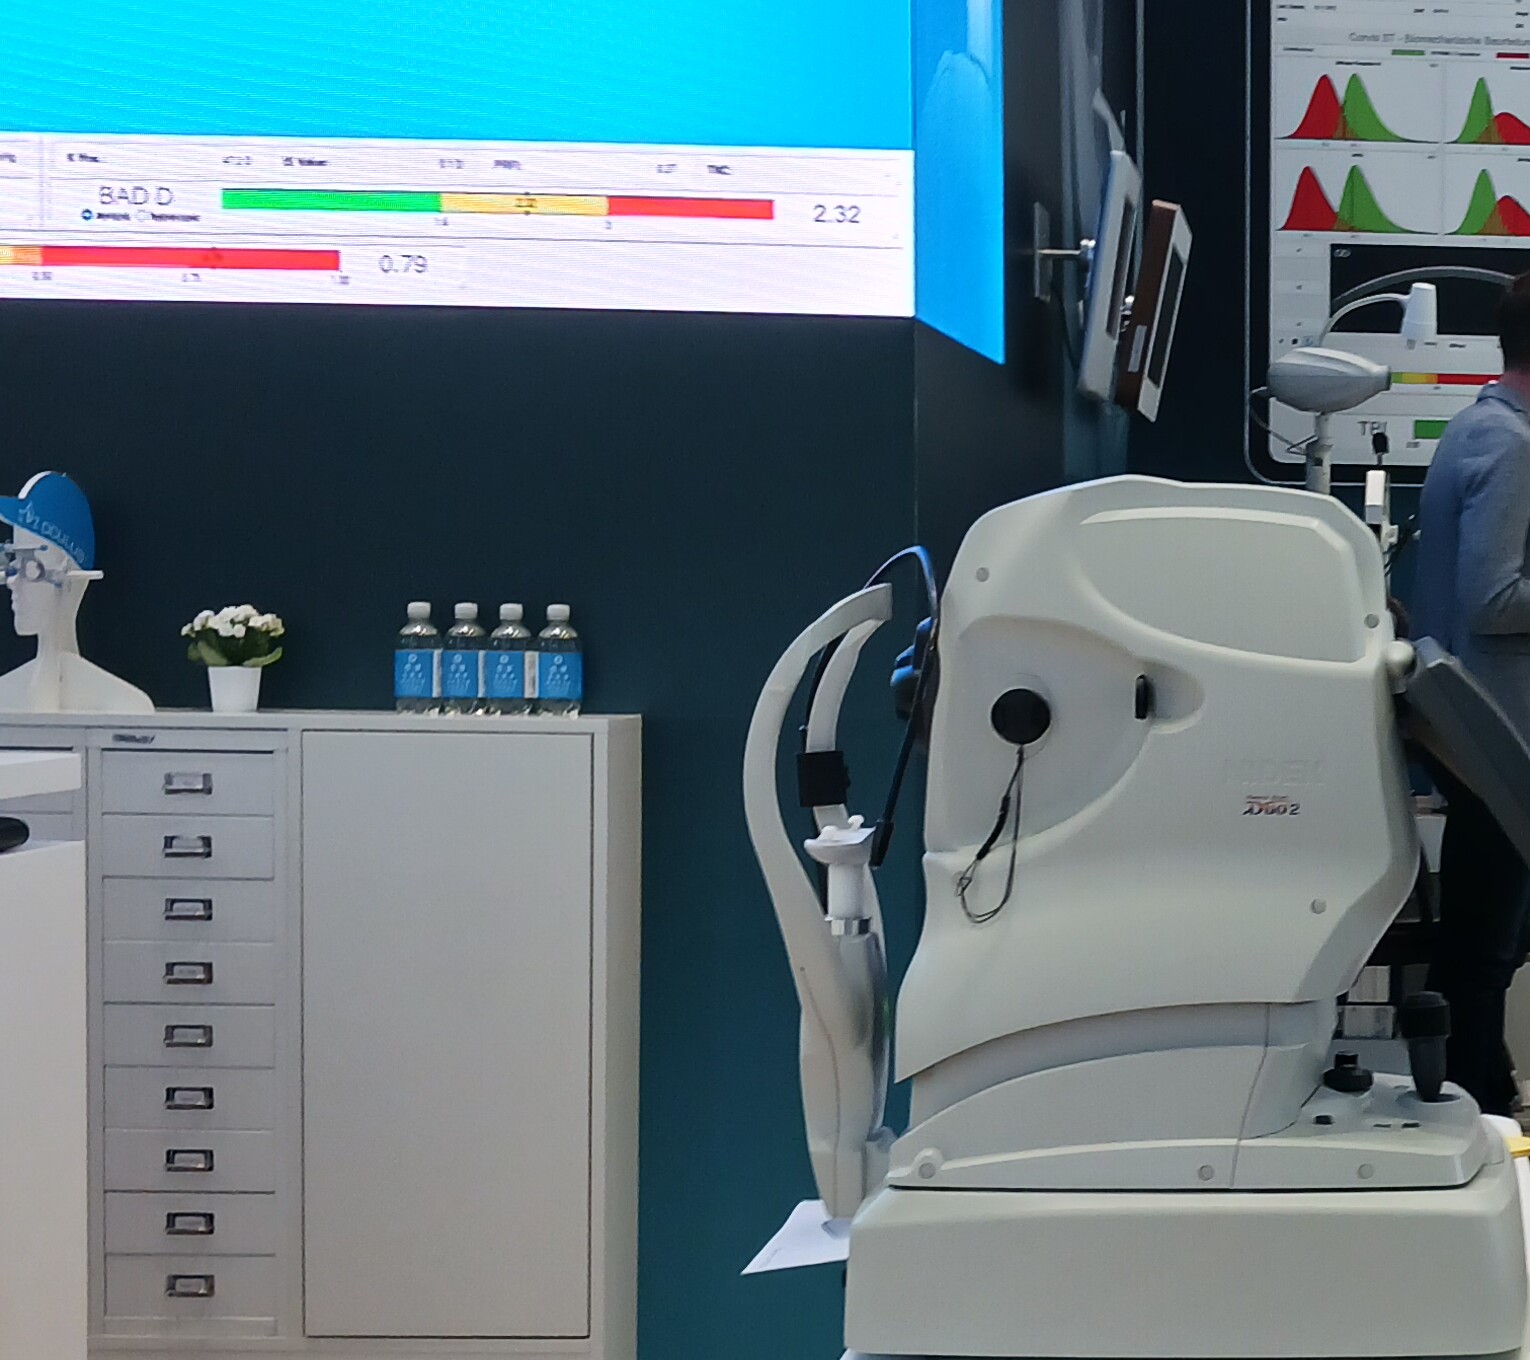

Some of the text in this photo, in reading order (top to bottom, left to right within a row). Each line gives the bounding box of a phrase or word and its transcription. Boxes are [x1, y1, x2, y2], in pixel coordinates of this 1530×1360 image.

[99, 186, 175, 206] BAD D
[811, 204, 861, 224] 2.32
[379, 253, 429, 275] 0.79
